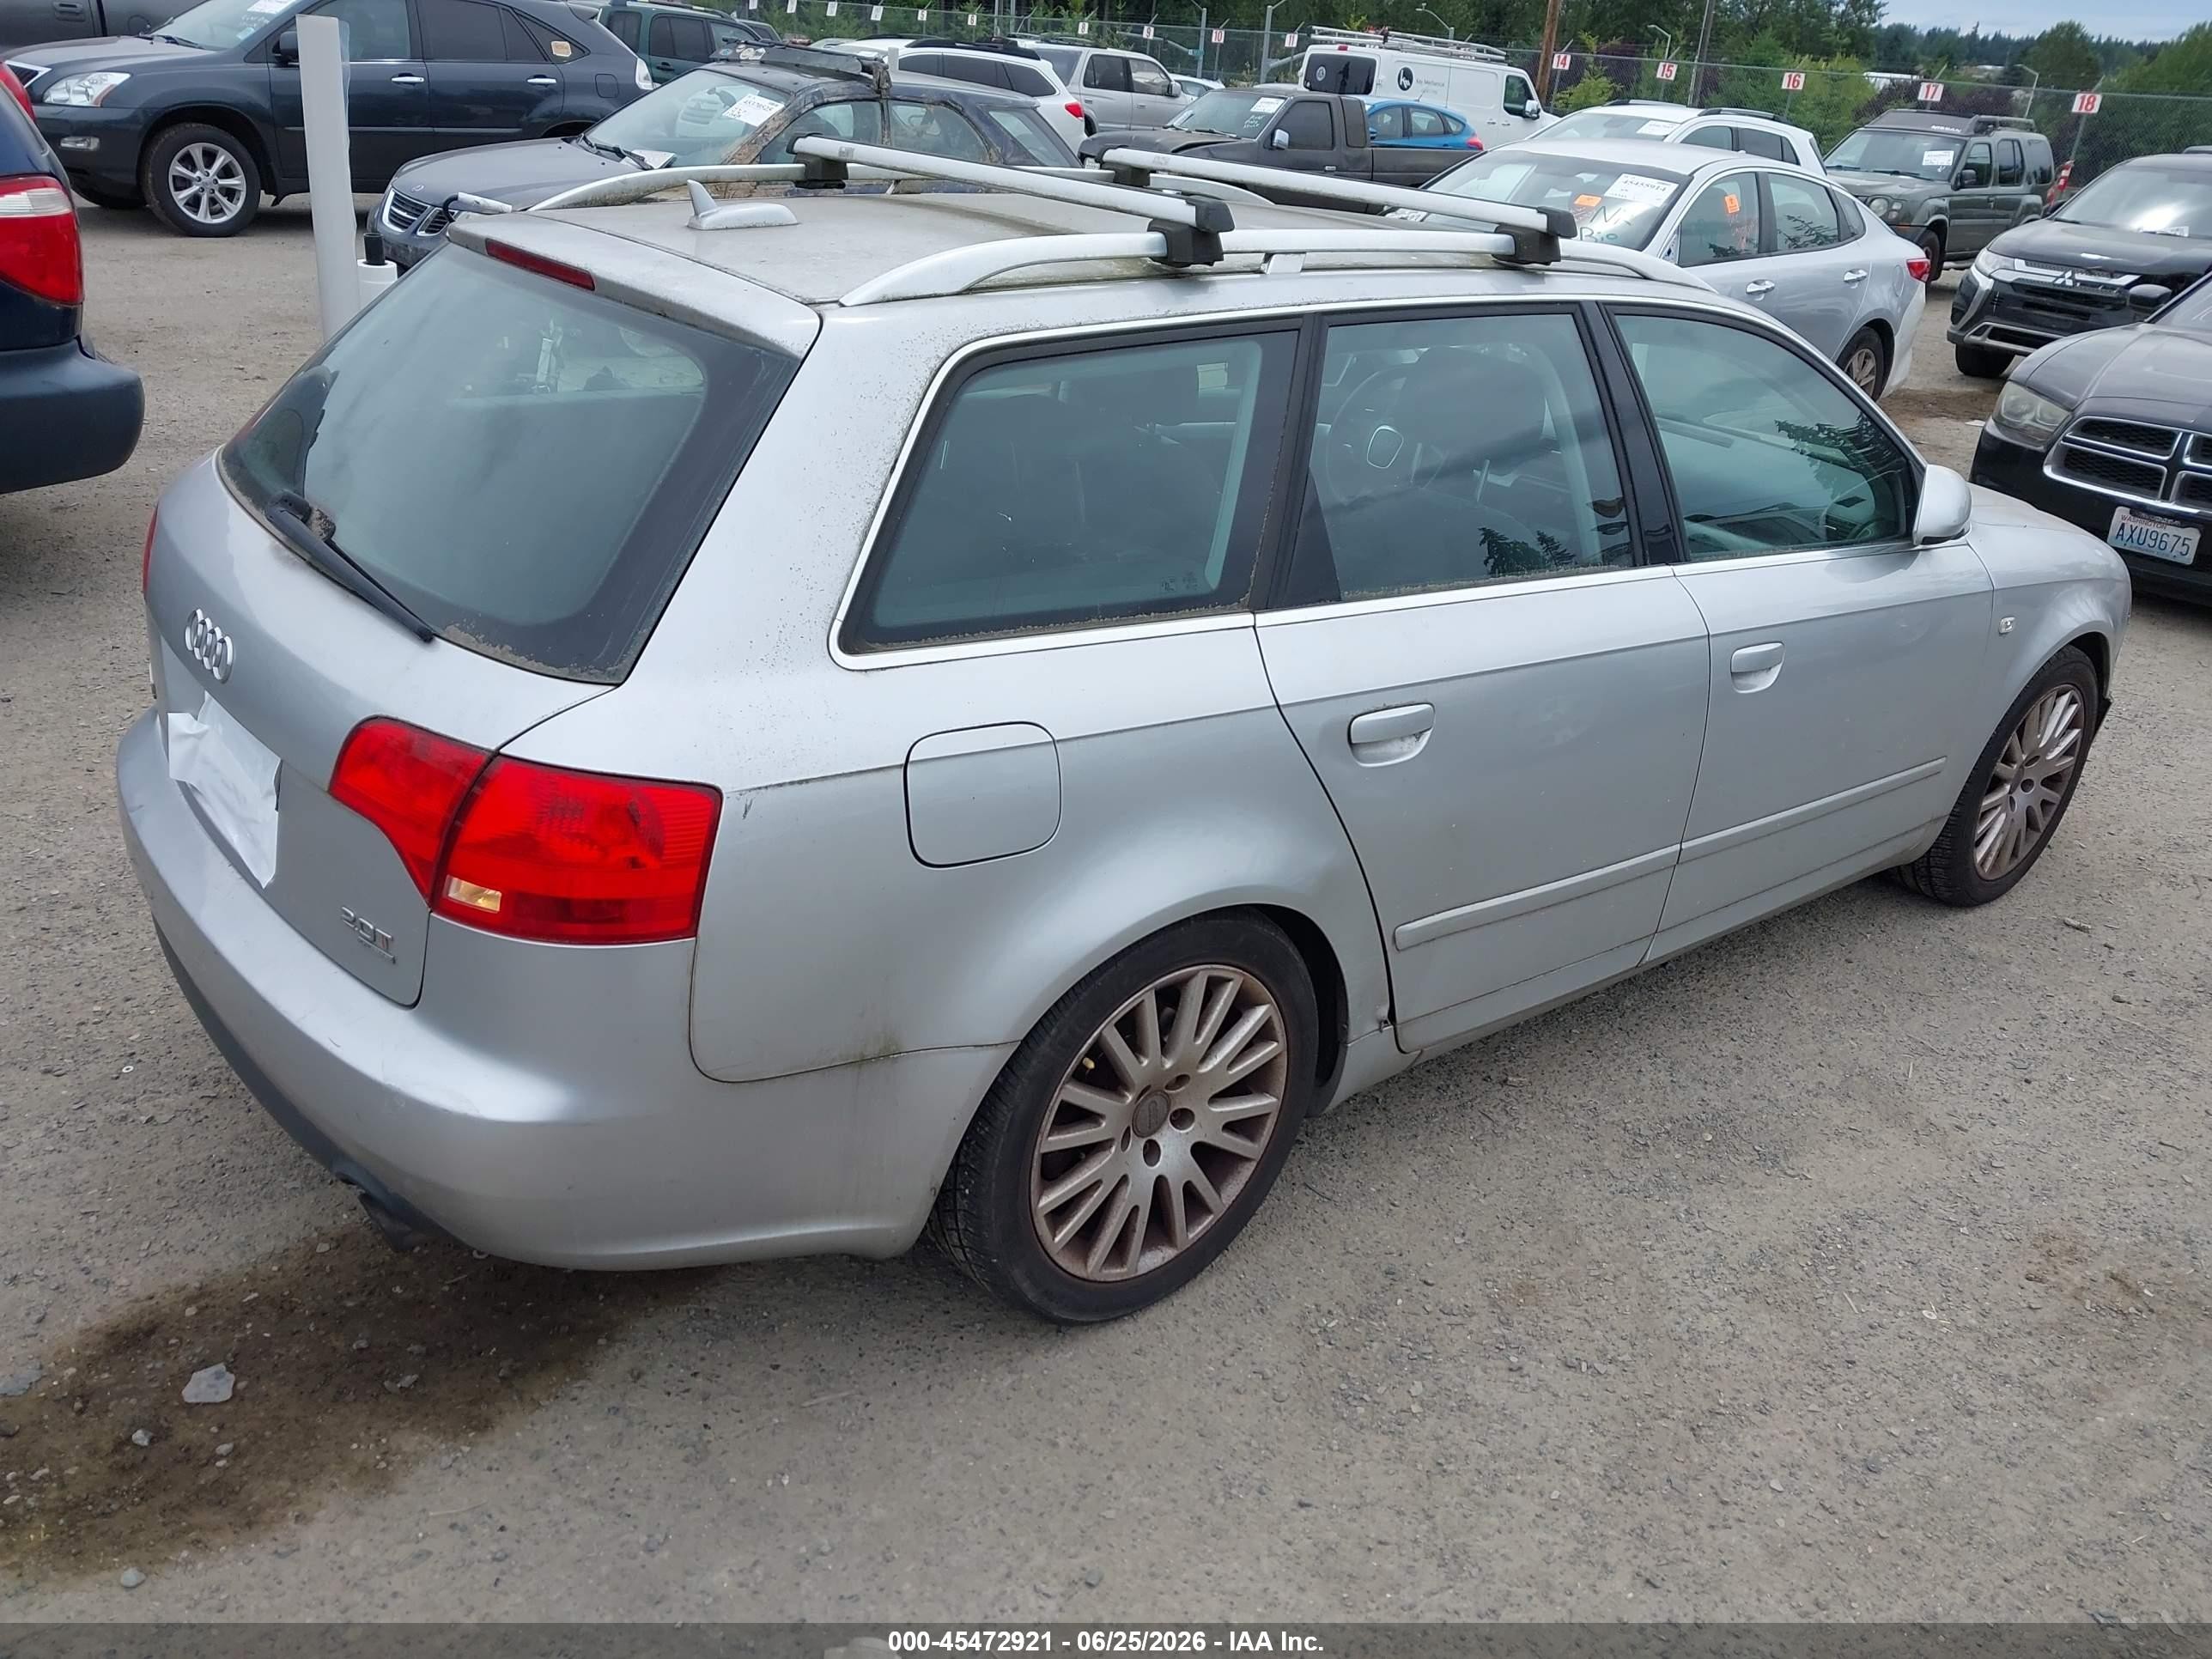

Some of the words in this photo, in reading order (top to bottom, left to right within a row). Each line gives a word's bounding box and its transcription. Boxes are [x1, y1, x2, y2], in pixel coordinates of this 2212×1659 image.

[1213, 30, 1223, 42] 10
[1289, 34, 1296, 46] 11
[1555, 55, 1567, 69] 14
[1661, 63, 1674, 78] 15
[1785, 74, 1801, 88] 16
[1923, 84, 1939, 100] 17
[2077, 95, 2096, 112] 18
[2121, 514, 2168, 530] WASHINGTON
[2115, 522, 2193, 557] AXU9675
